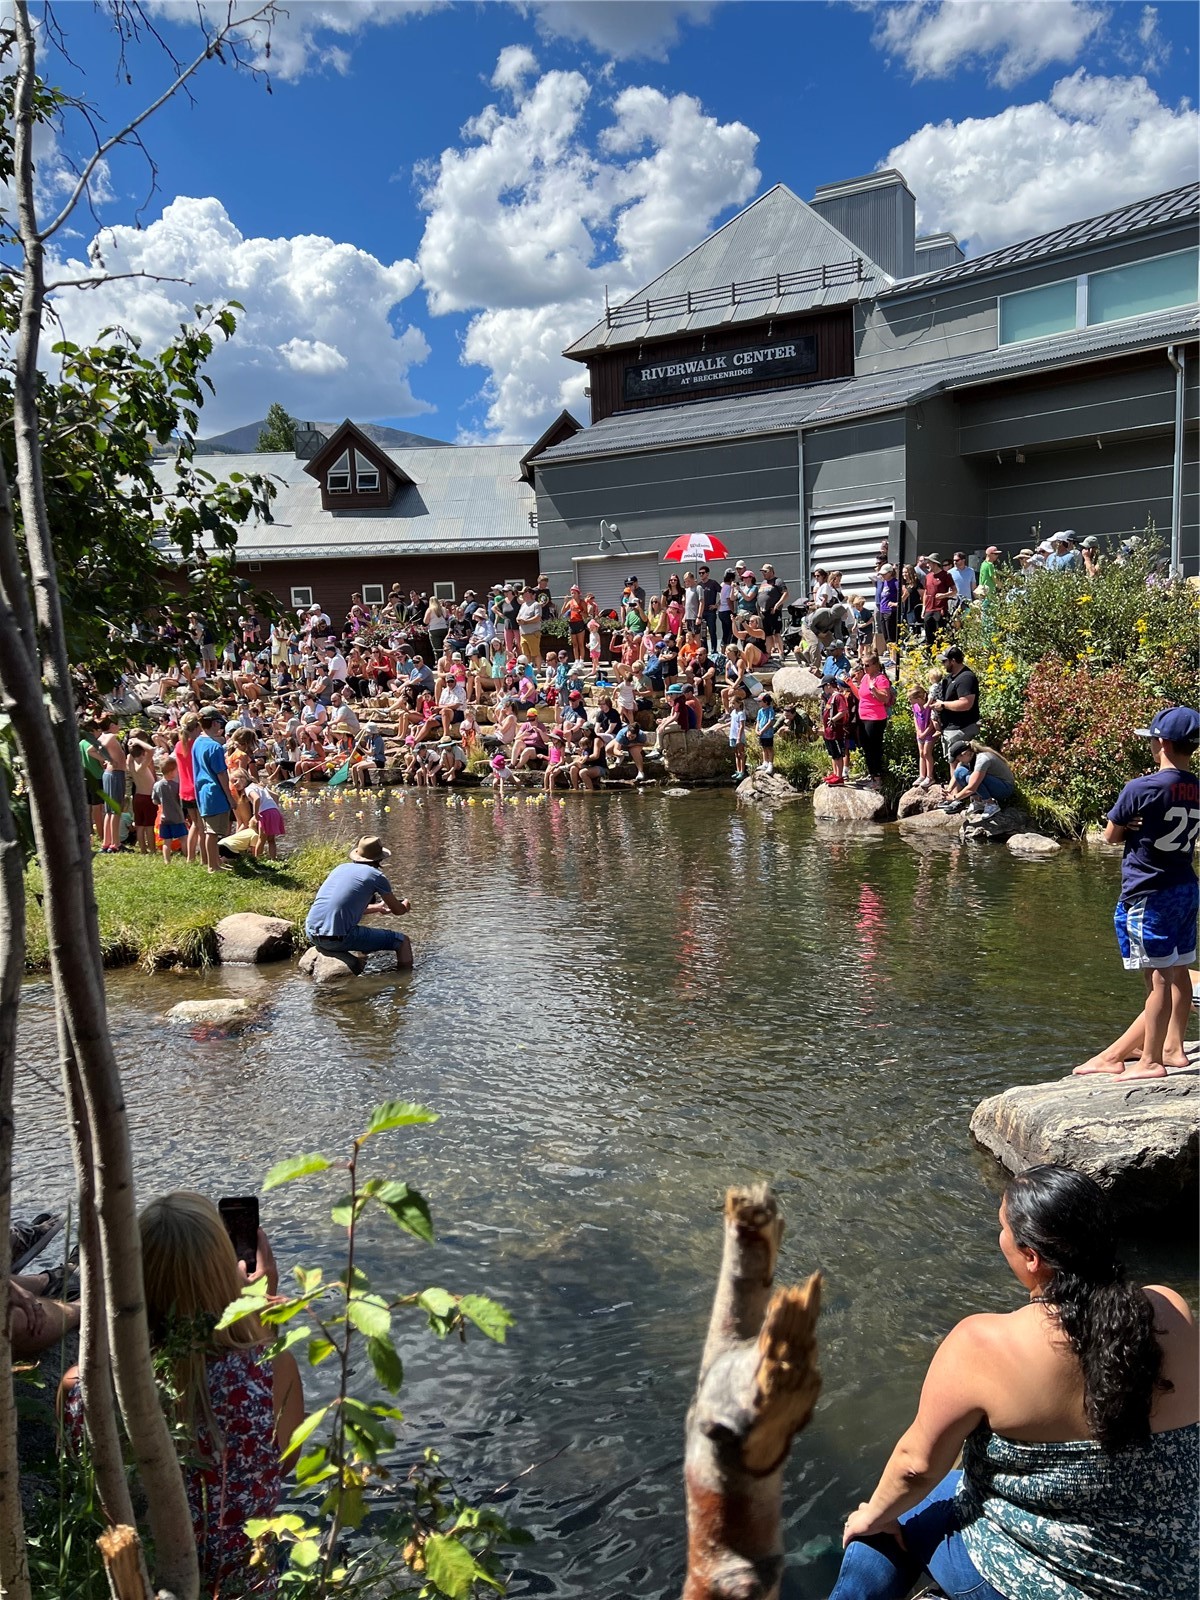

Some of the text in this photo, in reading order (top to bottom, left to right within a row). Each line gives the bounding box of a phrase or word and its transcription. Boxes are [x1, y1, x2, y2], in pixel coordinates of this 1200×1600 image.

[641, 345, 797, 381] RIVERWALK CENTER
[693, 367, 753, 383] BRECKENRIDGE
[1153, 806, 1199, 852] 27
